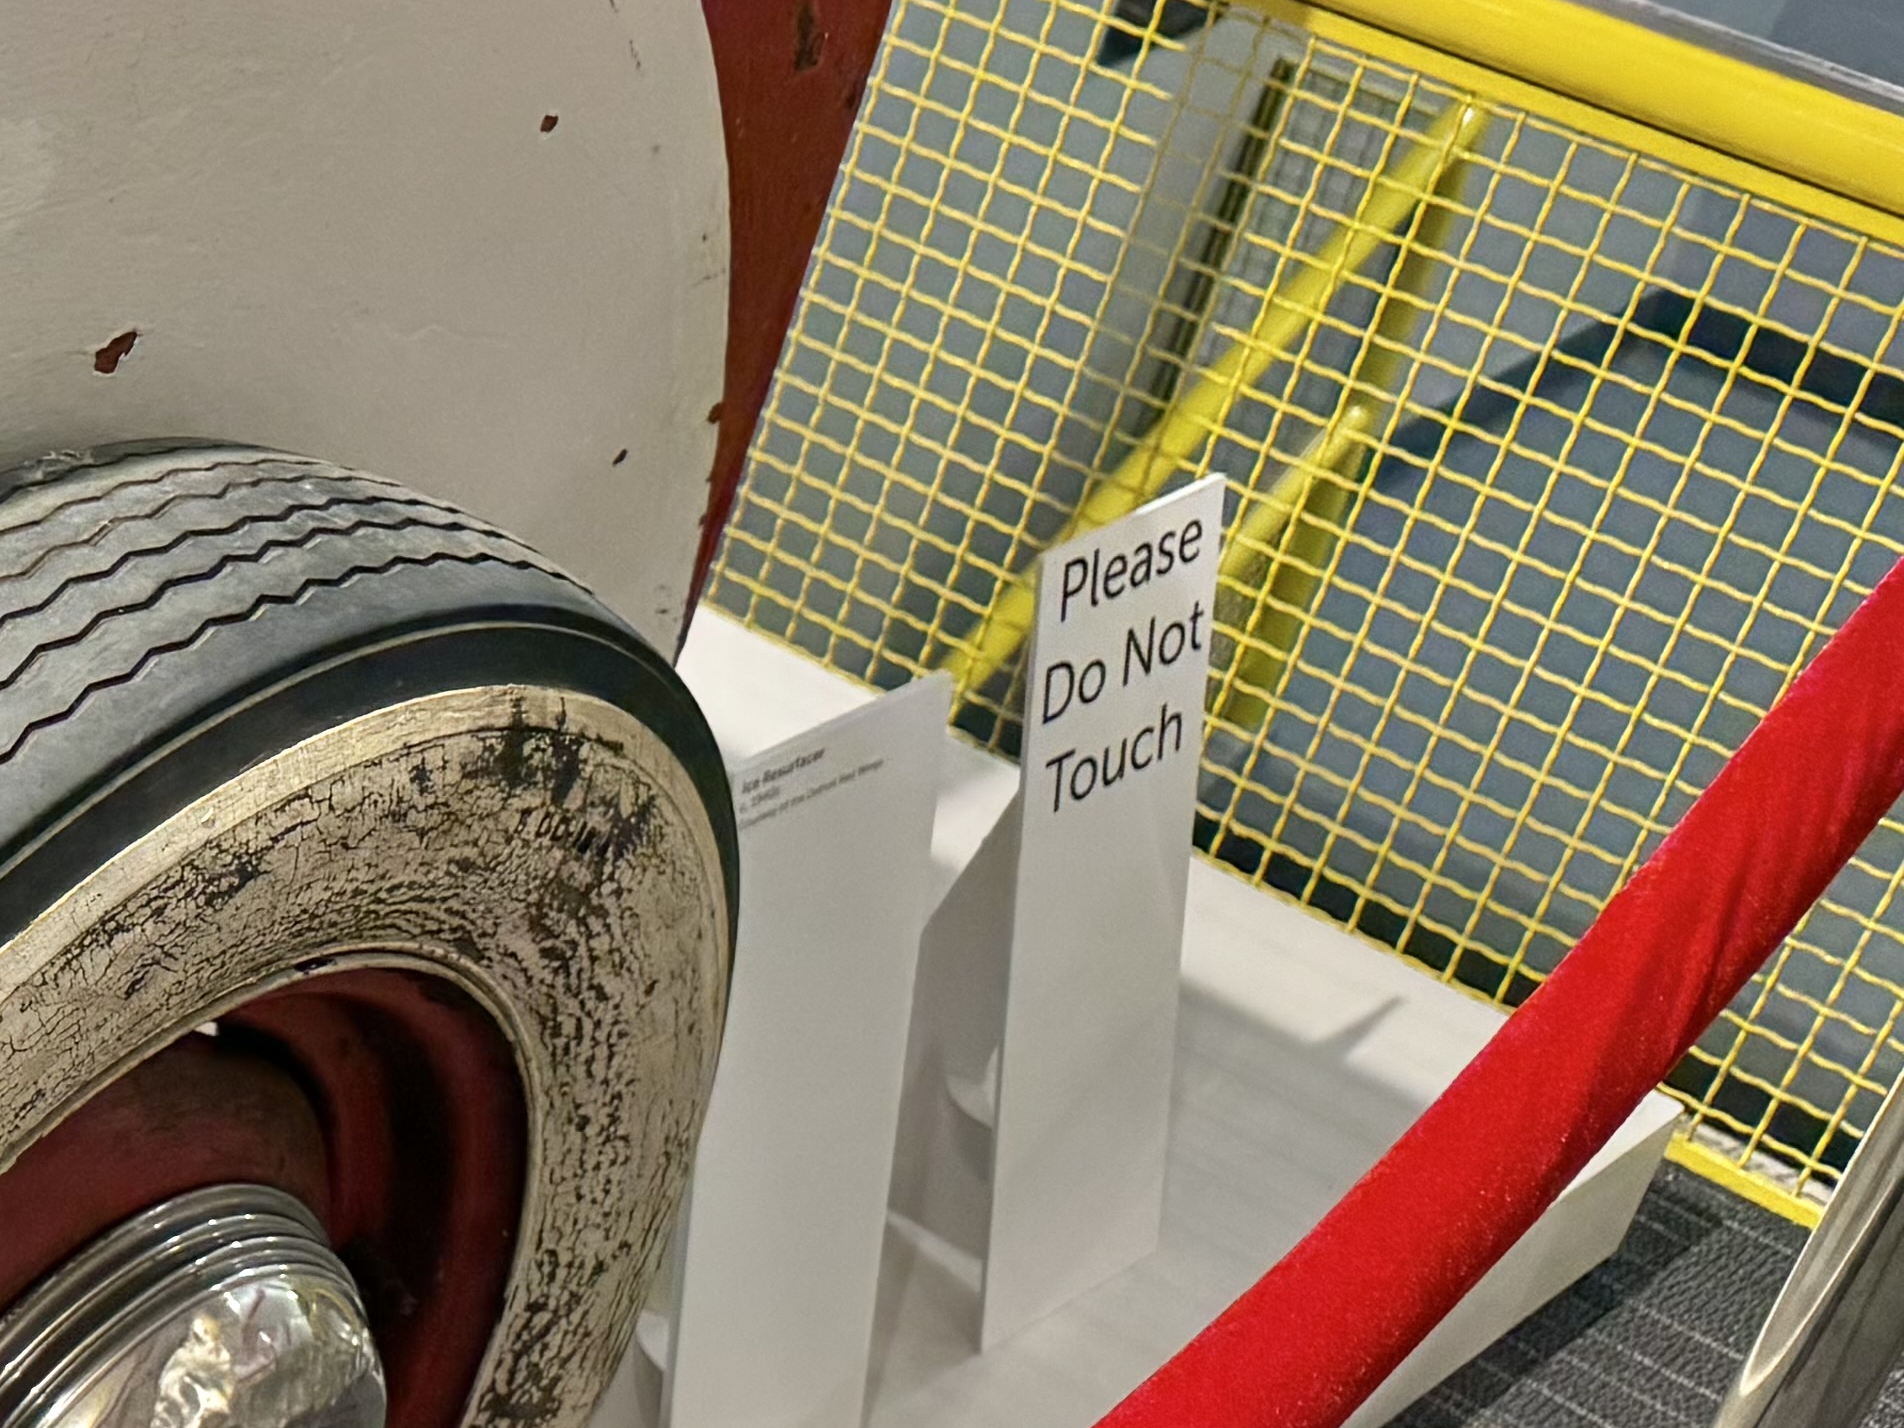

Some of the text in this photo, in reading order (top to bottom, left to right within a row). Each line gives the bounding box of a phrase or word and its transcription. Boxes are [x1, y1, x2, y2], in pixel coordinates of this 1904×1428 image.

[1060, 518, 1203, 623] Please
[1041, 599, 1205, 726] Do Not
[1044, 701, 1183, 813] Touch
